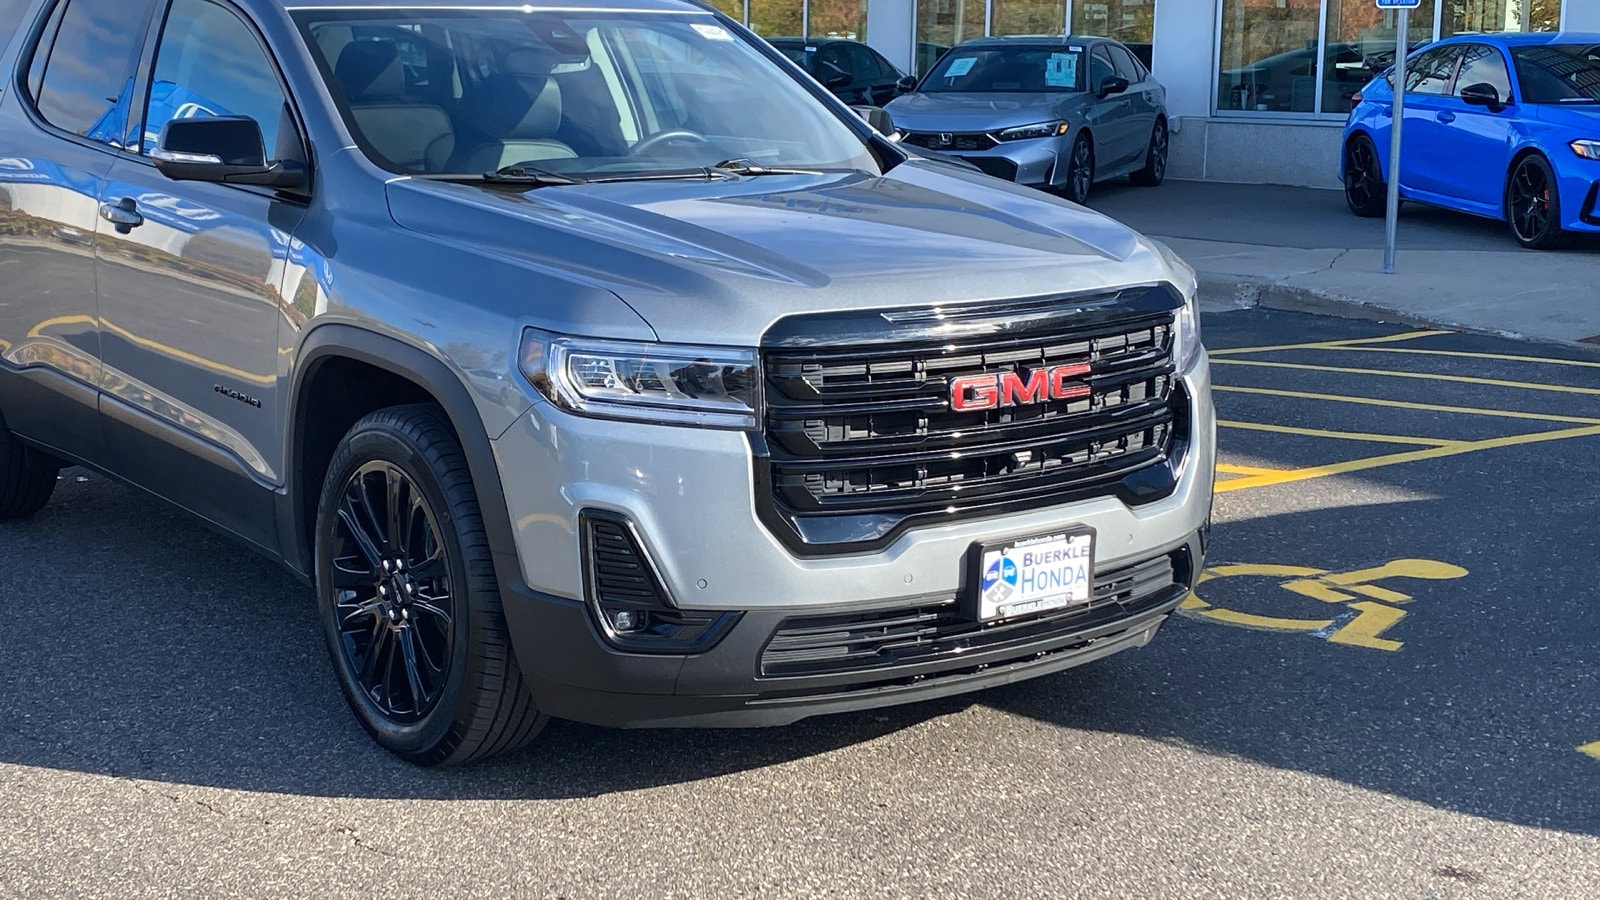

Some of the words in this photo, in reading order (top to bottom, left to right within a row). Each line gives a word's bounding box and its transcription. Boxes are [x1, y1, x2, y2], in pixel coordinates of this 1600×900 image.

[950, 361, 1091, 411] GMC
[1023, 545, 1090, 567] BUERKLE
[1021, 564, 1086, 594] HONDA
